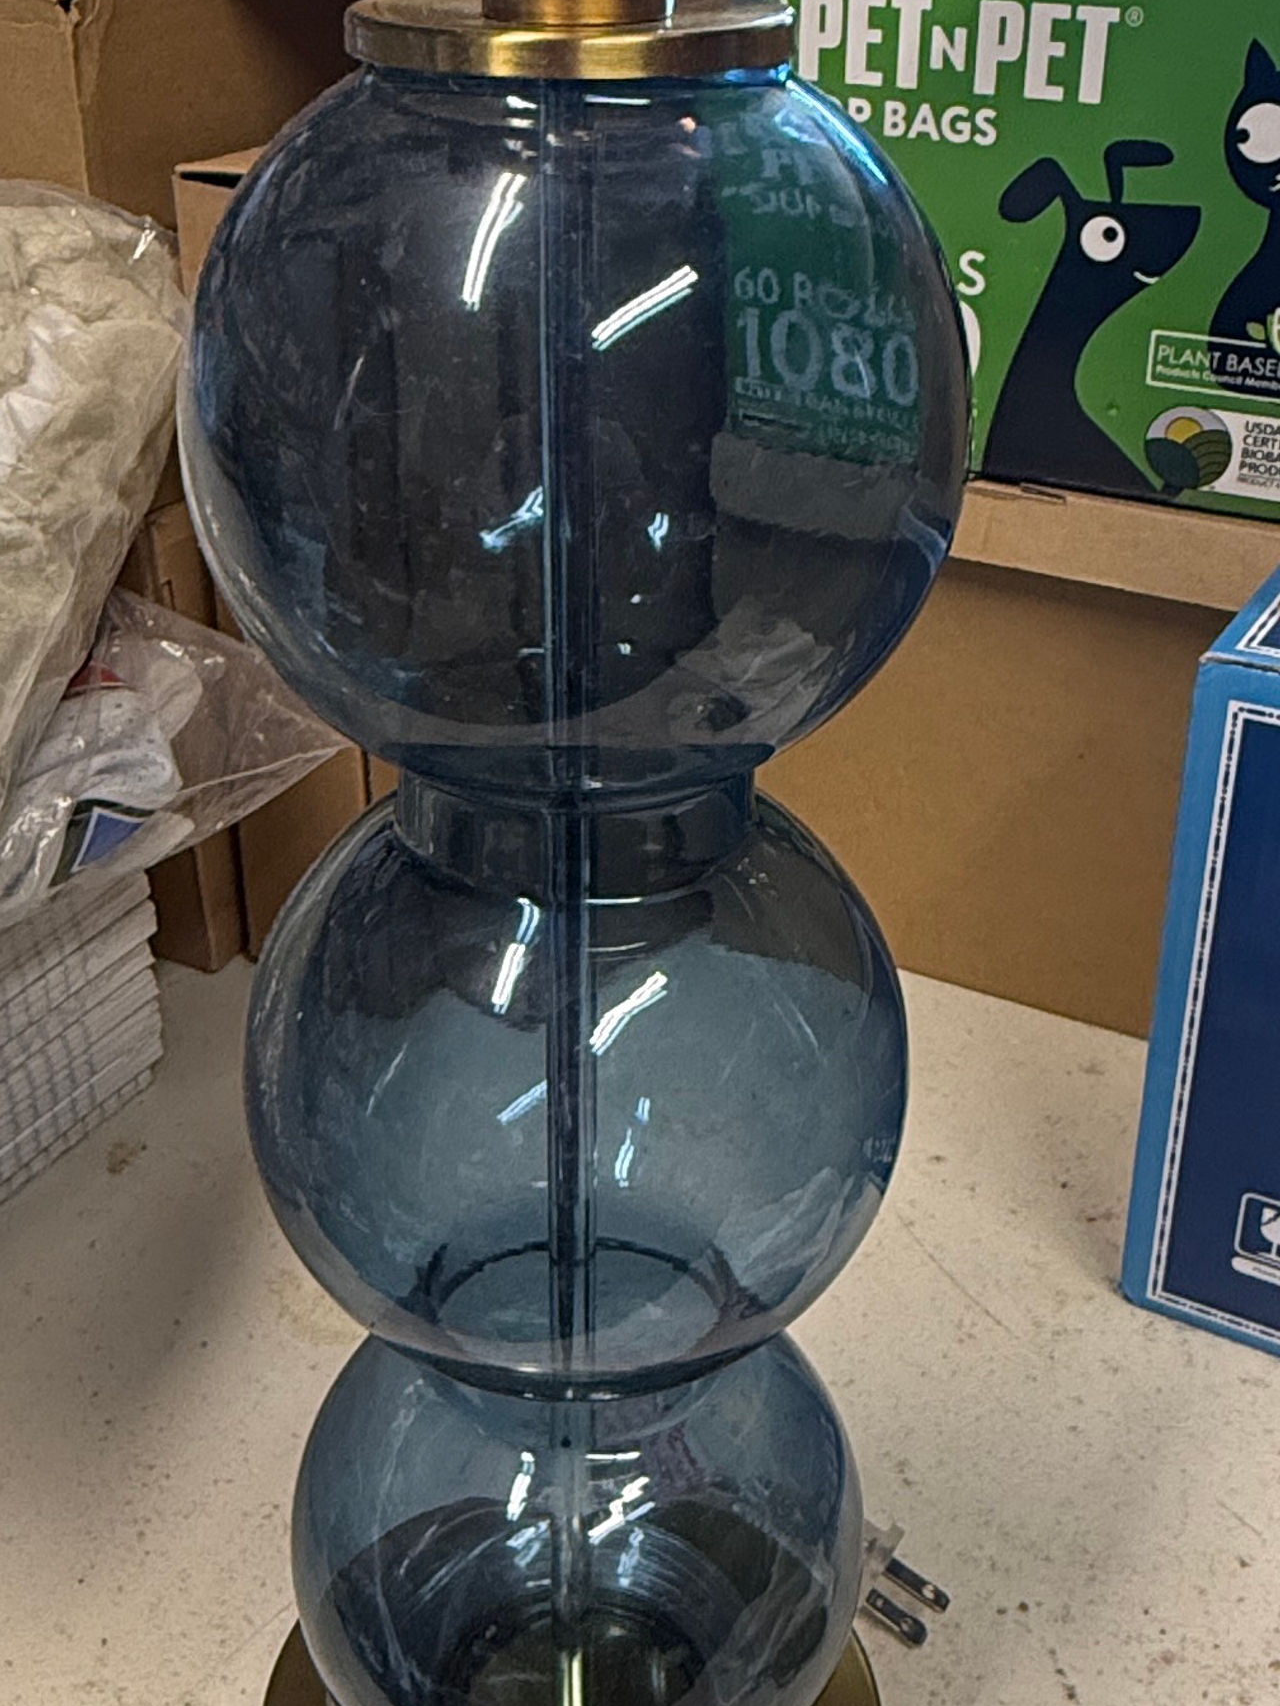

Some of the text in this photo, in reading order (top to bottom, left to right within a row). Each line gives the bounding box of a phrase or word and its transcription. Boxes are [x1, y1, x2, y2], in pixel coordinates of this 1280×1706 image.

[883, 99, 998, 146] BAGS
[737, 307, 919, 406] 1080
[1156, 365, 1202, 380] Products
[1157, 345, 1222, 370] PLANT
